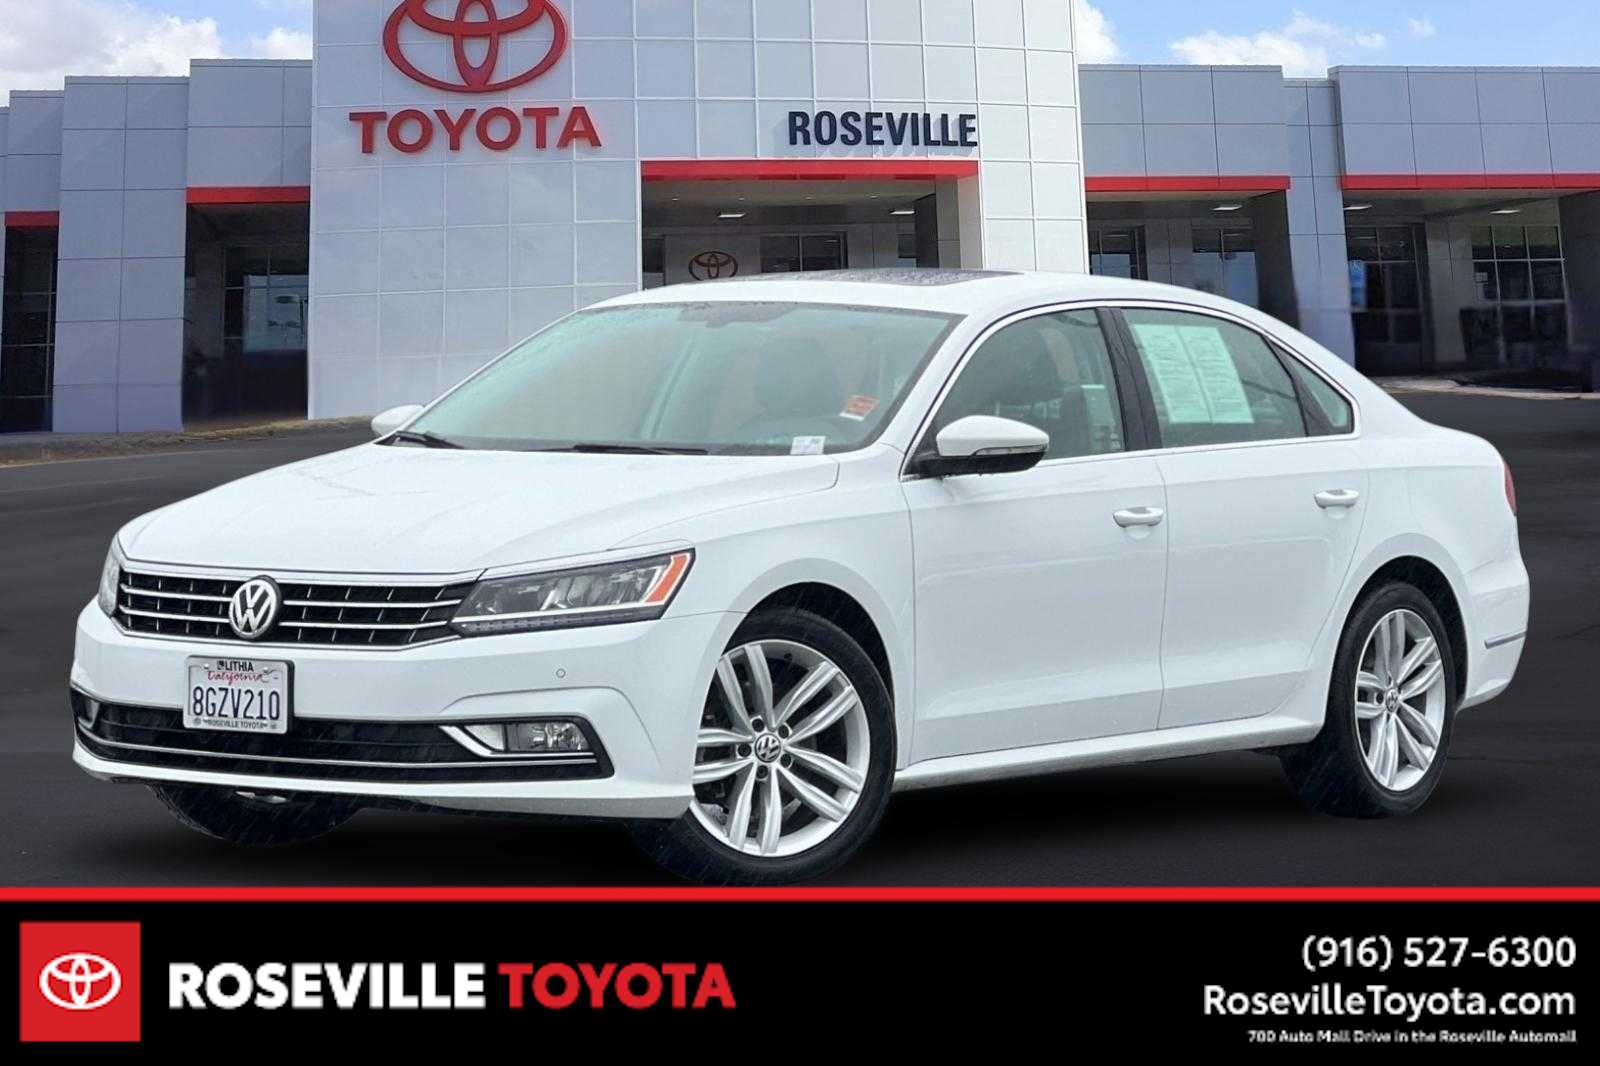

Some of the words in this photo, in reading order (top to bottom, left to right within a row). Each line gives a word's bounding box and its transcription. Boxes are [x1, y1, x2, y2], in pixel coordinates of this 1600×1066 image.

[350, 106, 602, 154] TOYOTA
[788, 111, 978, 147] ROSEVILLE
[207, 670, 263, 685] California
[225, 660, 254, 671] LITHIA
[193, 686, 280, 720] 8GZV210
